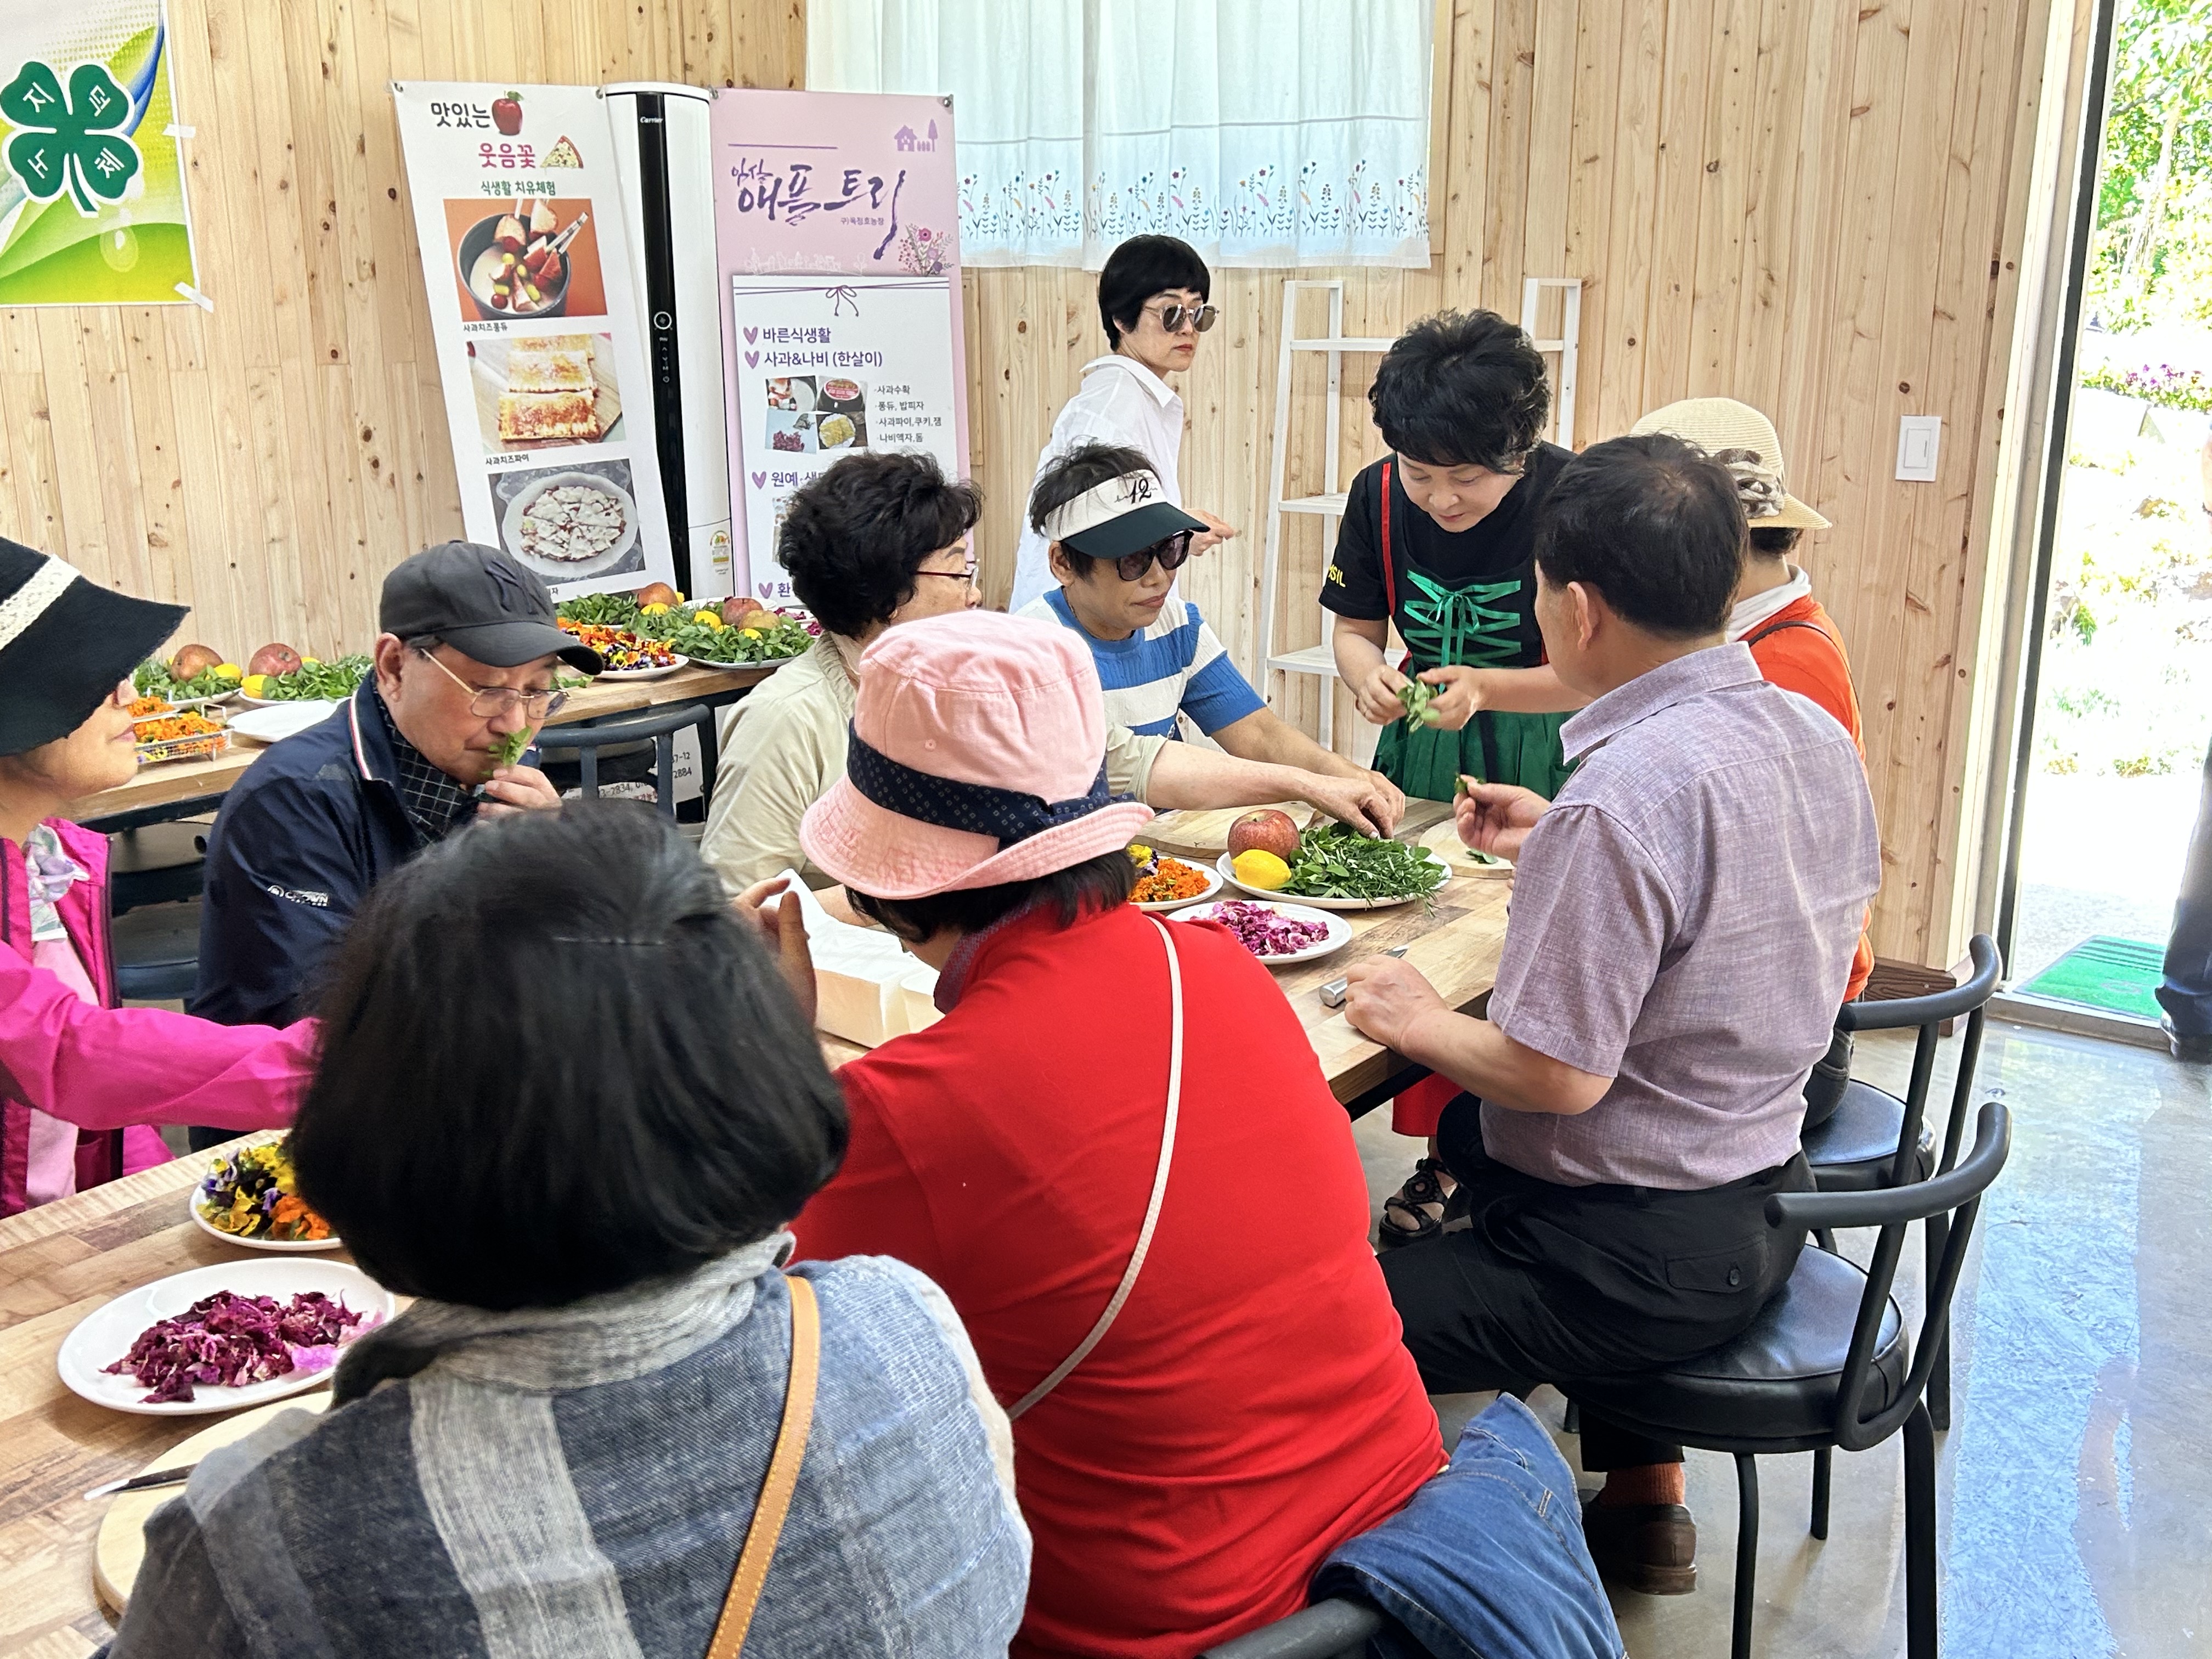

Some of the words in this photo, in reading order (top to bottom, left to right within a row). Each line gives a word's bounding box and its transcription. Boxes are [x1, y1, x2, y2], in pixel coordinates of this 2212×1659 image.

[22, 81, 55, 113] 지
[88, 84, 111, 117] 덕
[430, 102, 490, 128] 맛있는
[27, 148, 49, 179] 노
[94, 147, 125, 179] 체
[478, 142, 536, 169] 웃음꽃
[481, 180, 511, 196] 식생활
[515, 180, 556, 196] 치유체험
[463, 321, 508, 332] 사과치즈퐁듀
[763, 327, 832, 344] 바른식생활
[764, 351, 829, 368] 사과&나비
[832, 351, 883, 368] (한살이)
[877, 385, 910, 395] 사과수확
[878, 401, 898, 411] 퐁듀,
[899, 401, 924, 411] 밥피자
[486, 453, 529, 466] 사과치즈파이
